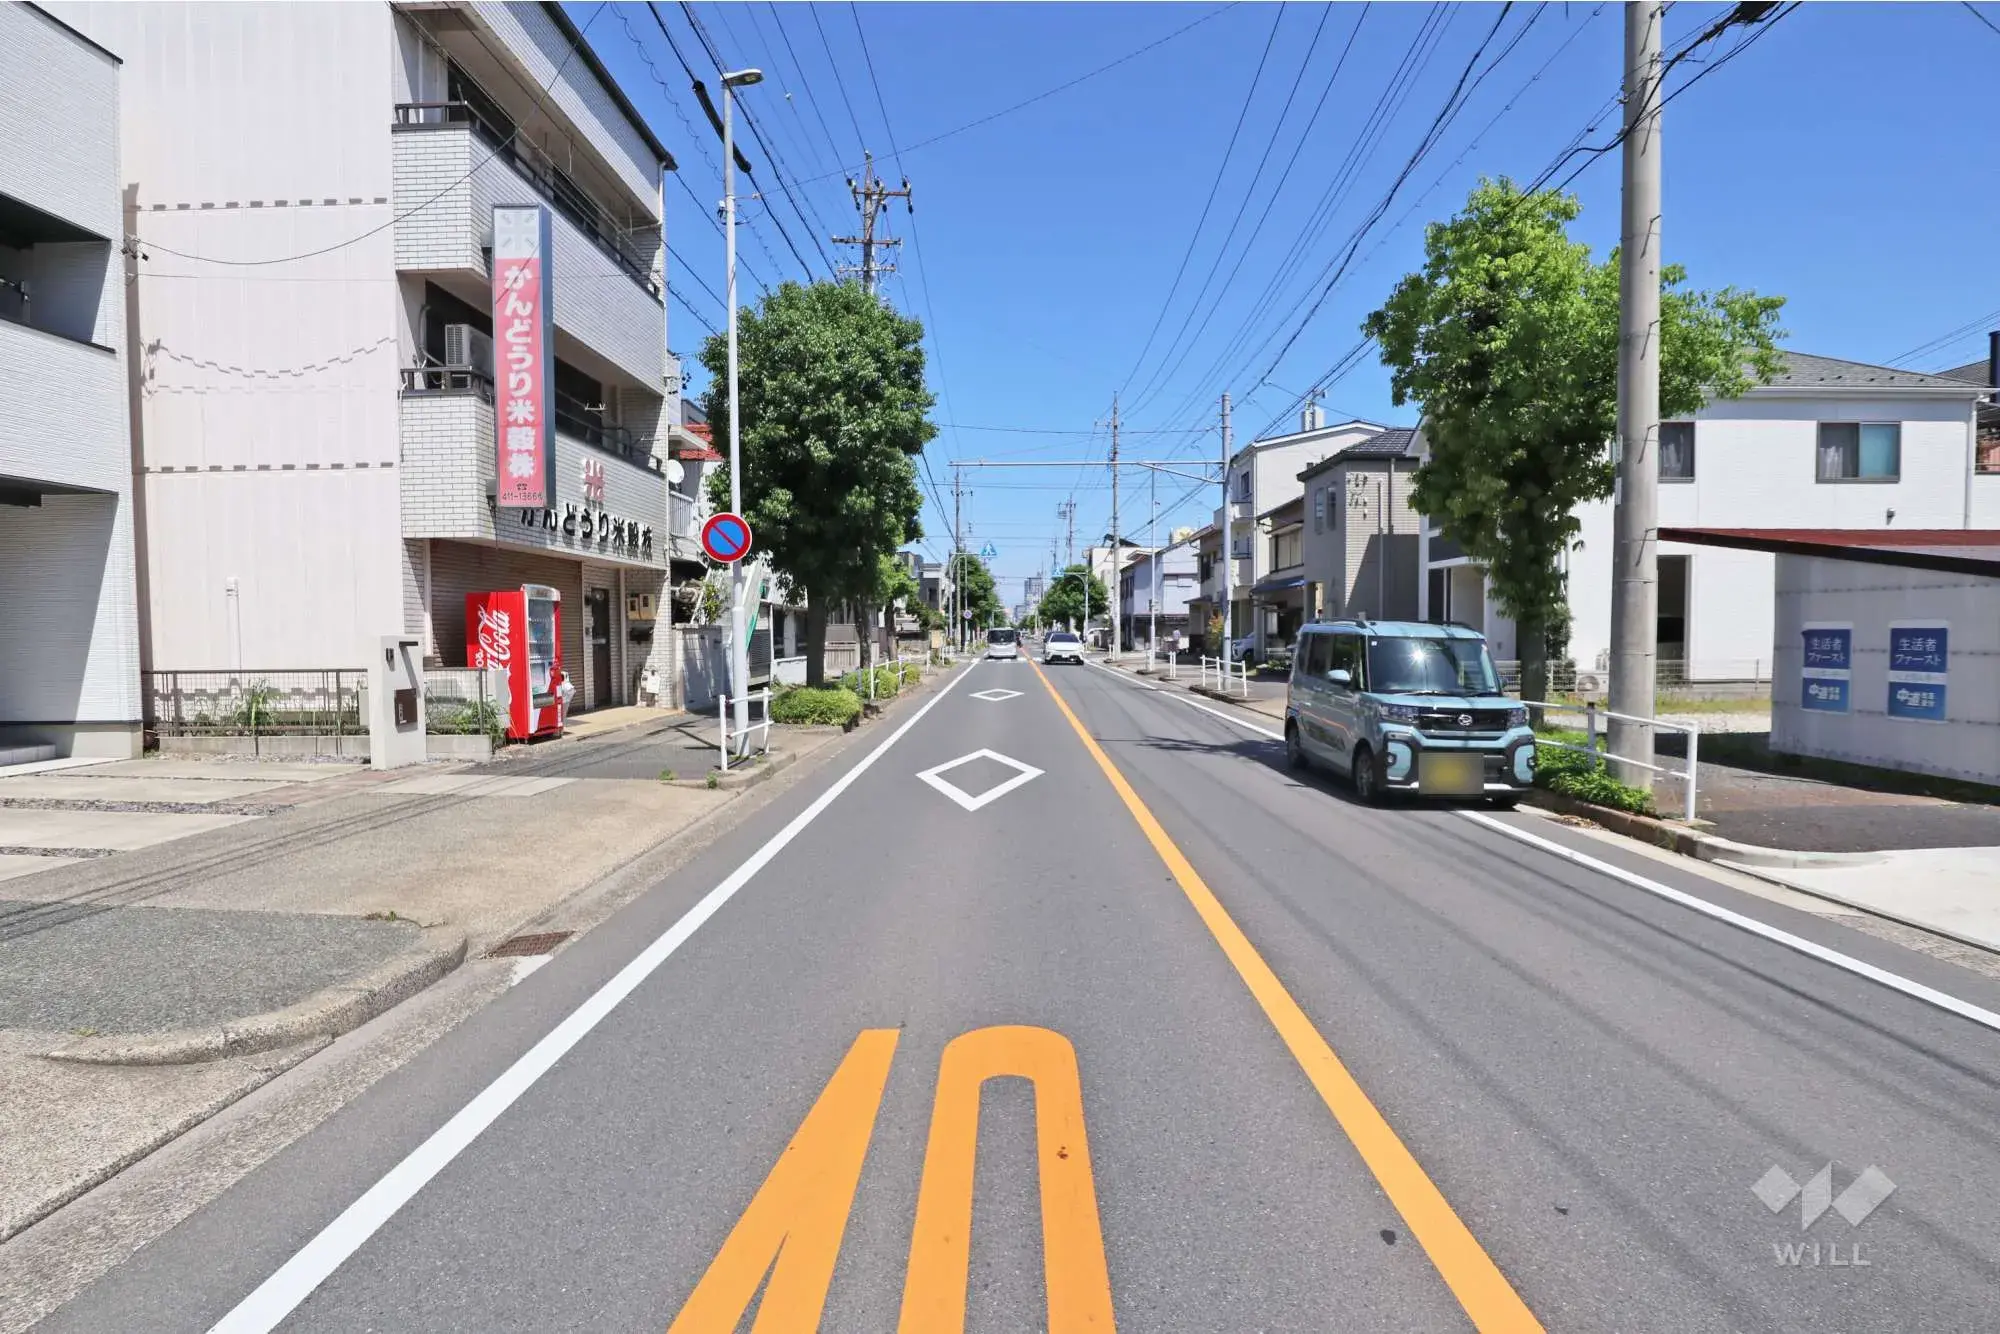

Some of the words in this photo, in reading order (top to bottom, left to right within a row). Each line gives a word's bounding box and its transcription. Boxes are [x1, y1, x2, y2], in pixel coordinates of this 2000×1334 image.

[1811, 637, 1842, 651] 生活者
[1898, 637, 1937, 652] 生活者
[1808, 652, 1846, 663] ファースト
[1896, 654, 1942, 665] ファースト
